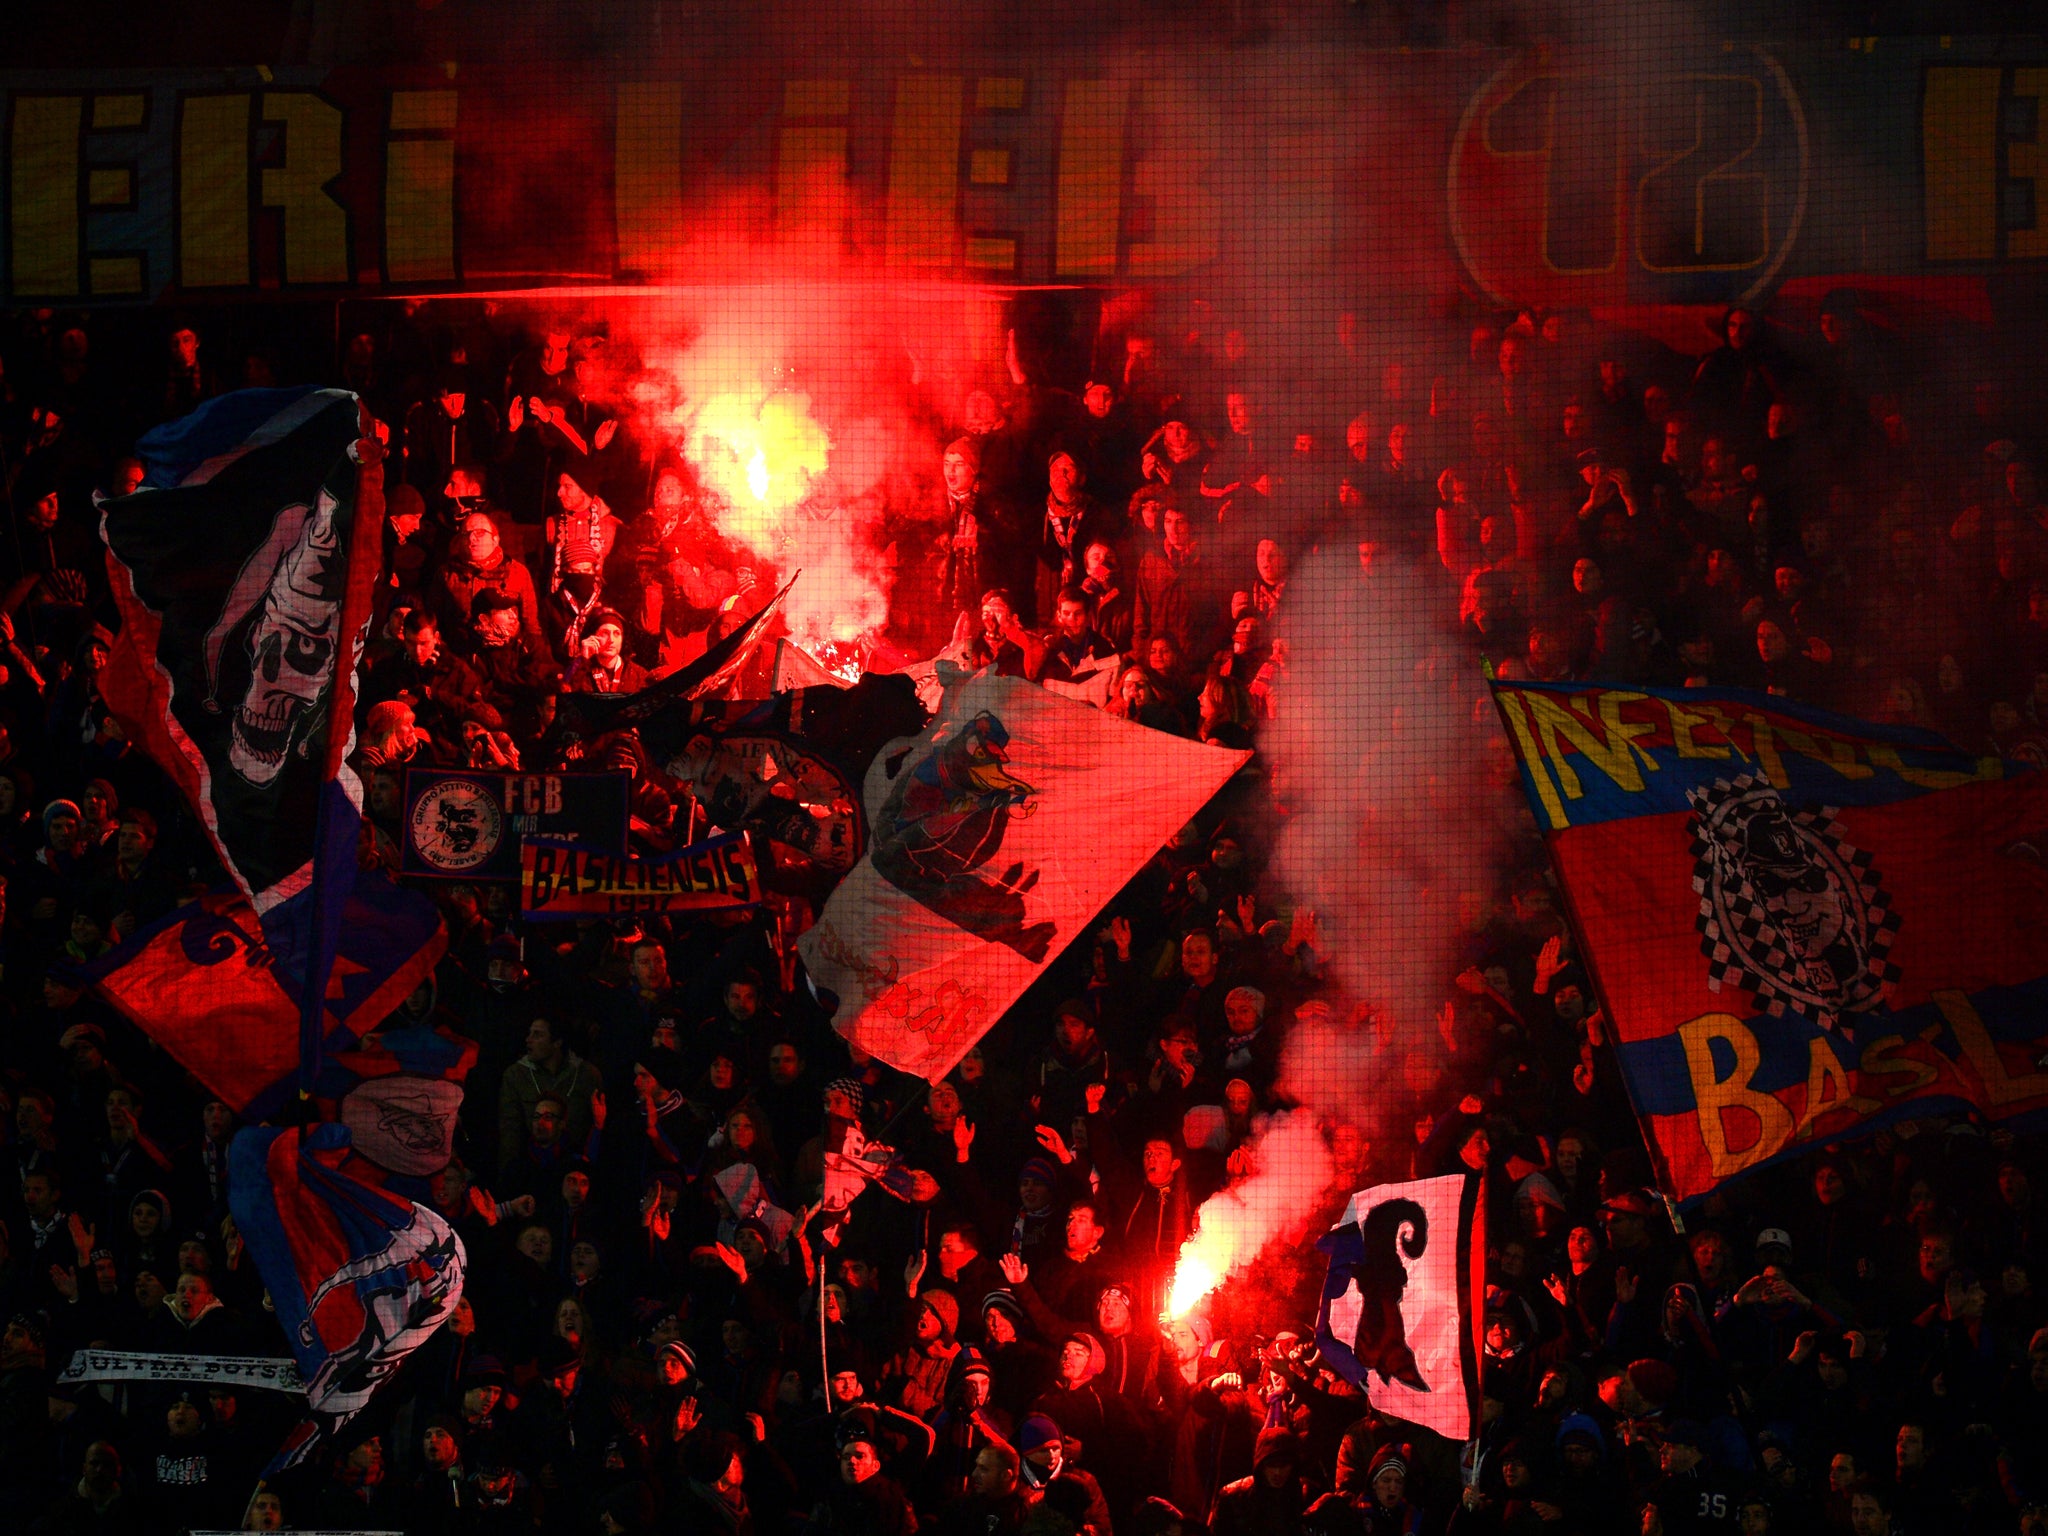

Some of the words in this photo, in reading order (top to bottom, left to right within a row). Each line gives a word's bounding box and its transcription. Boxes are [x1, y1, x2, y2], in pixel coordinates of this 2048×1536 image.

[415, 790, 438, 825] GRUPPO
[505, 775, 564, 815] FCB
[1677, 988, 2048, 1178] BASL
[90, 1356, 191, 1373] ULTRA
[205, 1362, 278, 1379] BOYS
[151, 1371, 214, 1380] BASEL
[1697, 1492, 1728, 1519] 35
